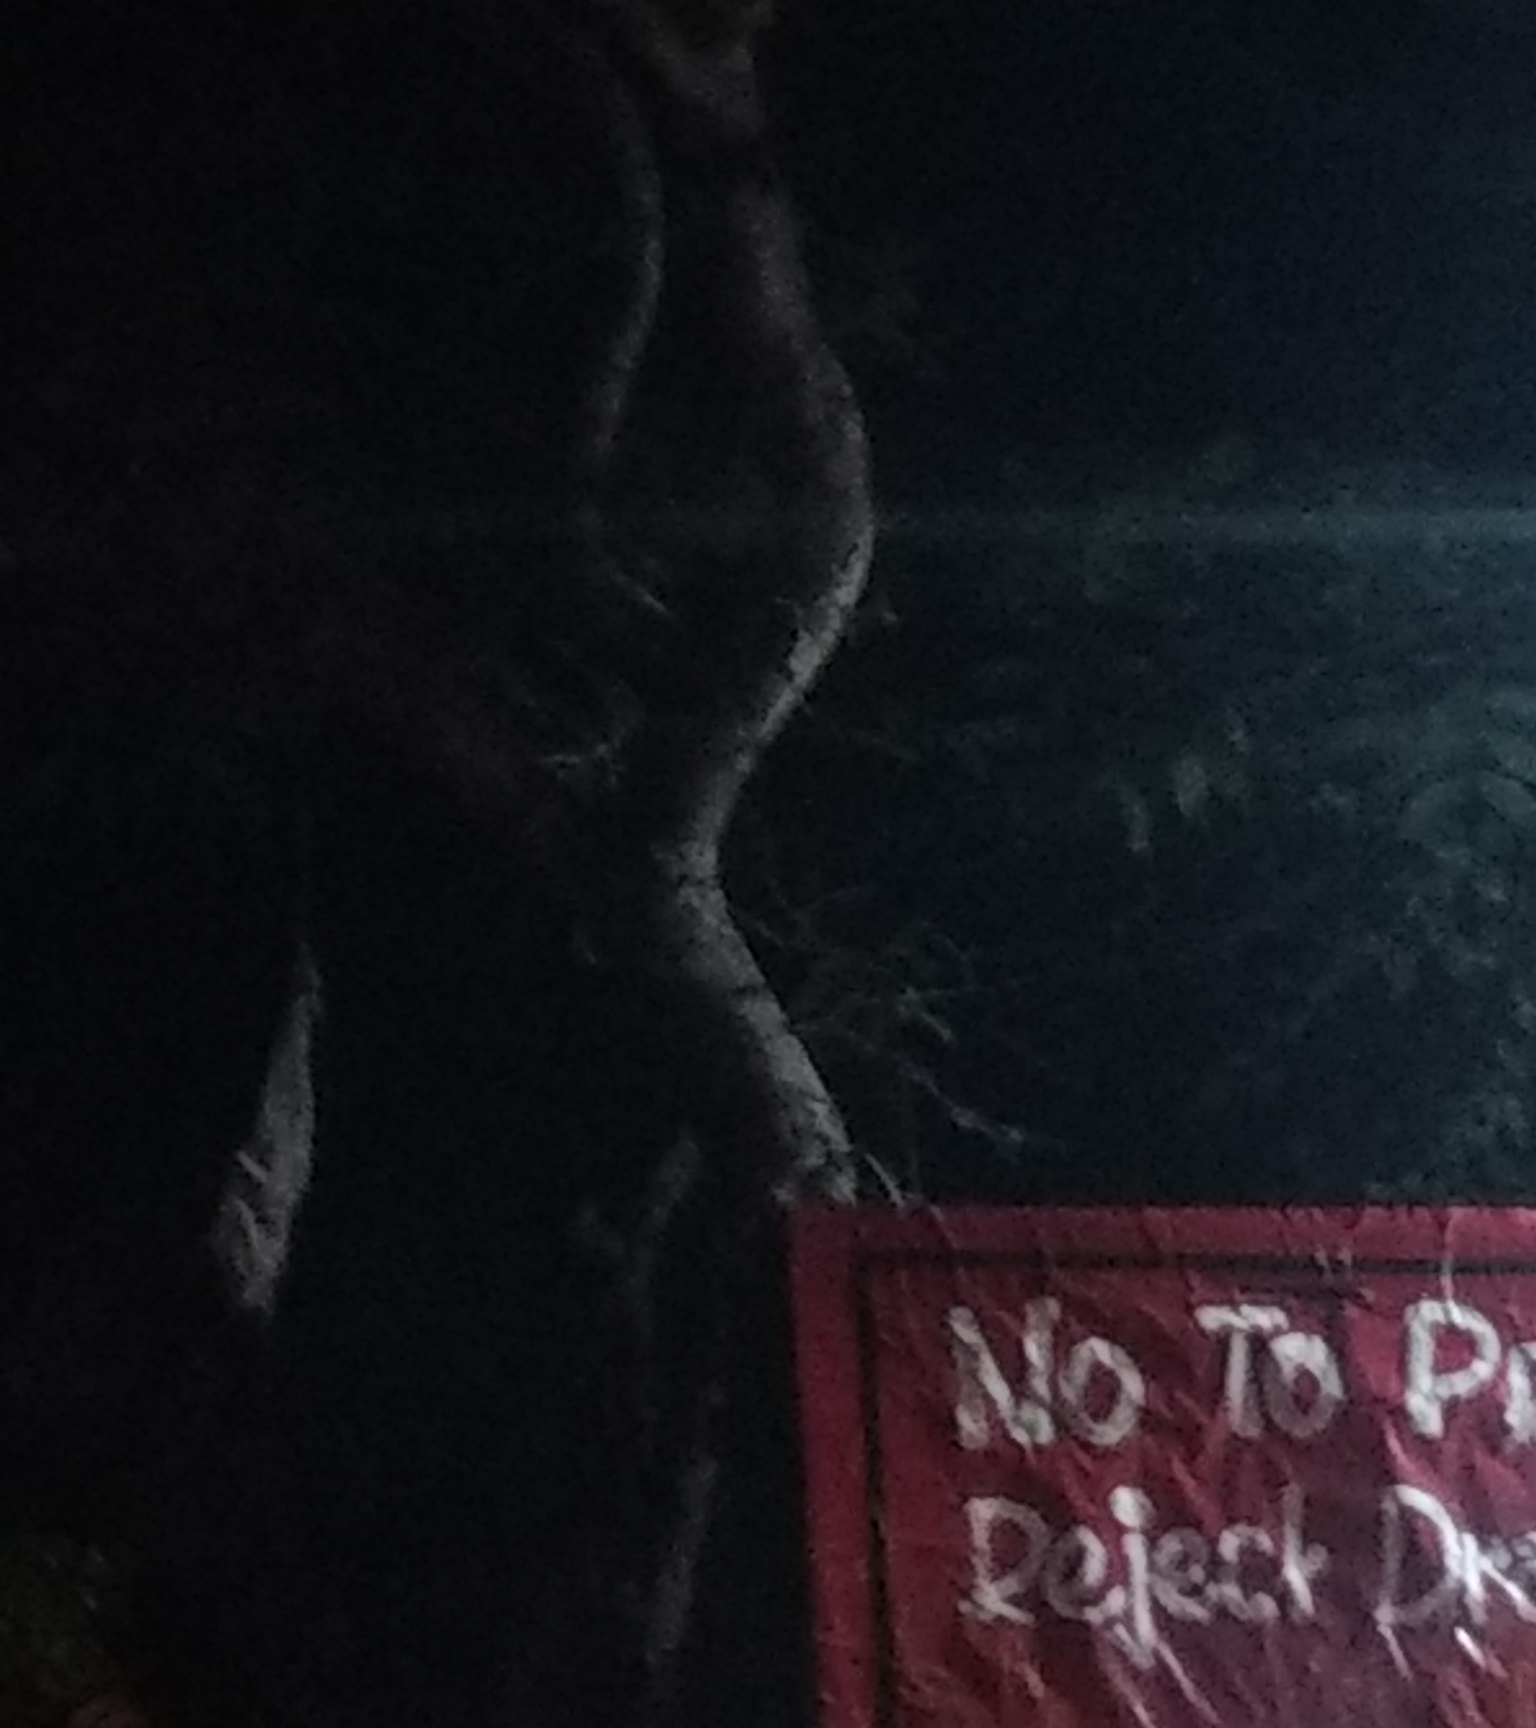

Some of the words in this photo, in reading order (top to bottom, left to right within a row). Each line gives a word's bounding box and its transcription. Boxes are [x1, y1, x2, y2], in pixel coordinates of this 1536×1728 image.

[949, 1297, 1146, 1450] NO
[1195, 1302, 1346, 1440] TO
[955, 1484, 1332, 1668] Reject
